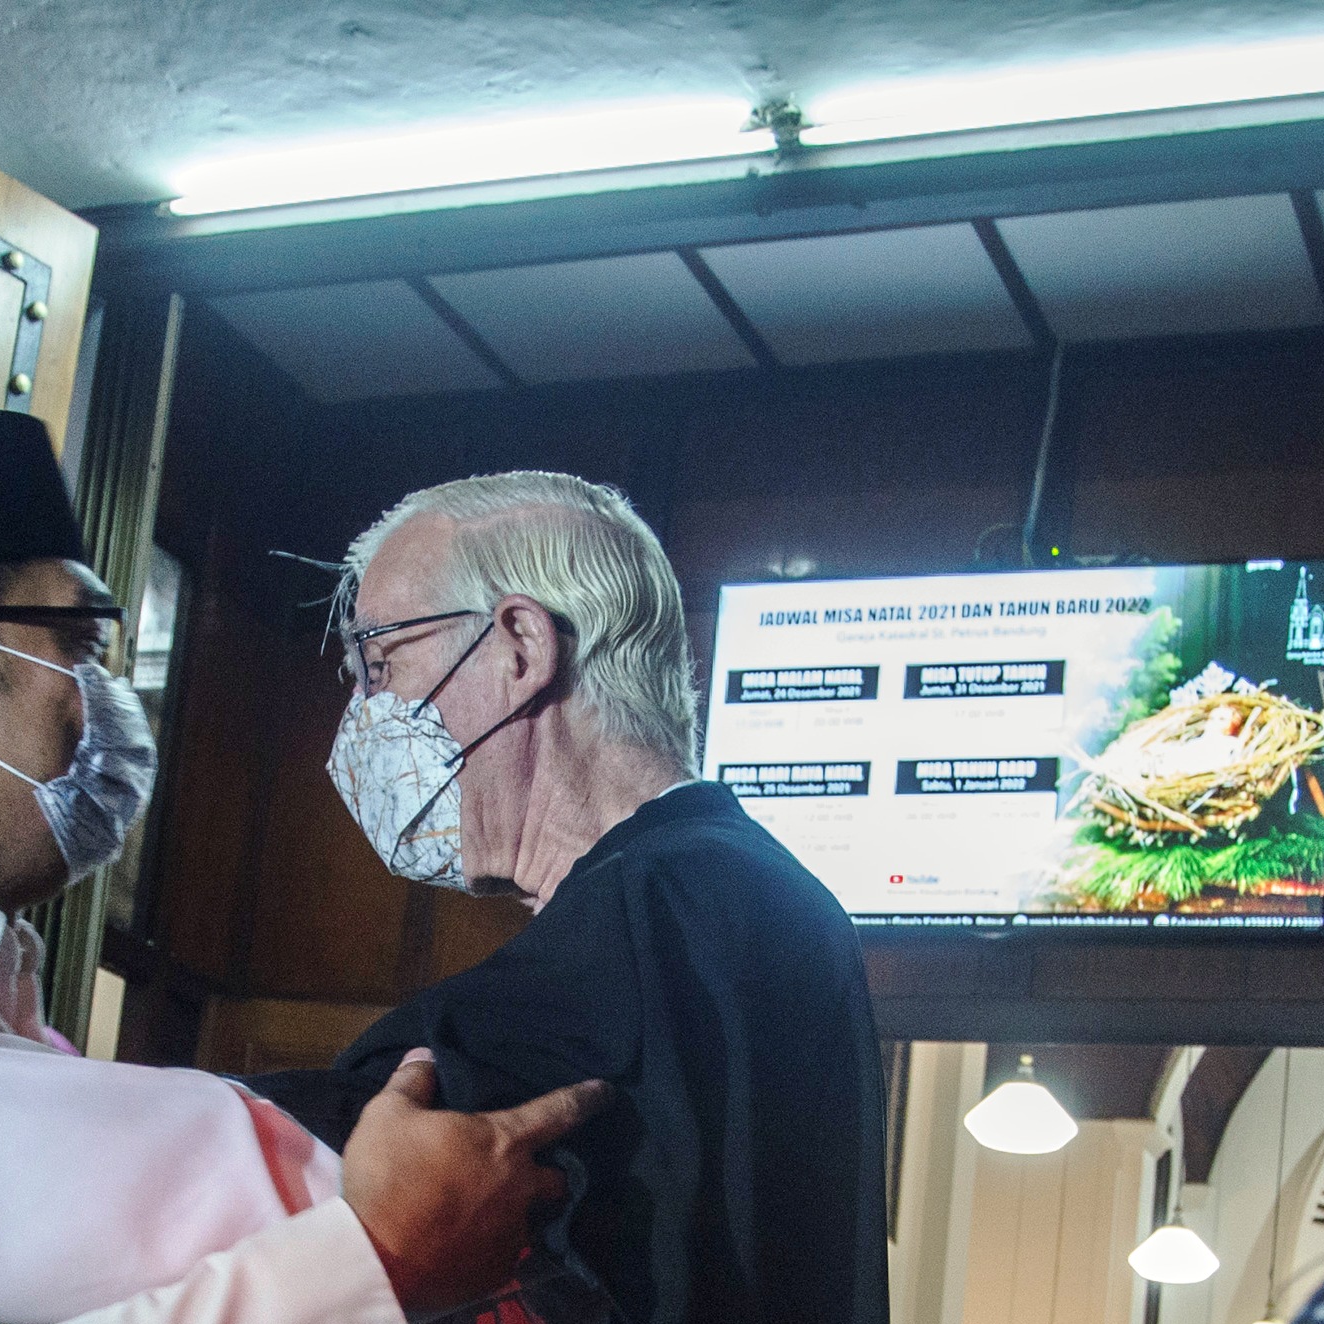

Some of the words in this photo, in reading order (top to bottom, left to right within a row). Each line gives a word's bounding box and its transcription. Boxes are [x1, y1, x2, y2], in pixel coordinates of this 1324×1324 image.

[759, 610, 817, 626] JADWAL
[823, 608, 863, 624] MISA
[867, 606, 912, 622] NATAL
[918, 604, 956, 620] 2021
[961, 603, 992, 618] DAN
[999, 601, 1051, 617] TAHUN
[1056, 598, 1100, 615] BARU
[1105, 597, 1151, 614] 2022
[951, 626, 990, 638] Petrus
[993, 624, 1047, 638] Bandung
[741, 671, 775, 688] MISA
[777, 670, 823, 687] MALAM
[824, 668, 864, 685] NATAL
[920, 666, 956, 684] MISA
[957, 665, 1001, 683] TUTUP
[1002, 663, 1047, 681] TAHUN
[787, 687, 836, 699] Desember
[837, 685, 861, 698] 2021
[968, 681, 1019, 694] Desember
[1020, 680, 1045, 693] 2021
[723, 766, 757, 783] MISA
[758, 766, 790, 783] HARI
[791, 765, 823, 782] RAYA
[824, 764, 864, 781] NATAL
[916, 761, 951, 778] MISA
[953, 760, 997, 778] TAHUN
[998, 760, 1037, 778] BARU
[777, 782, 825, 795] Desember
[826, 782, 851, 794] 2021
